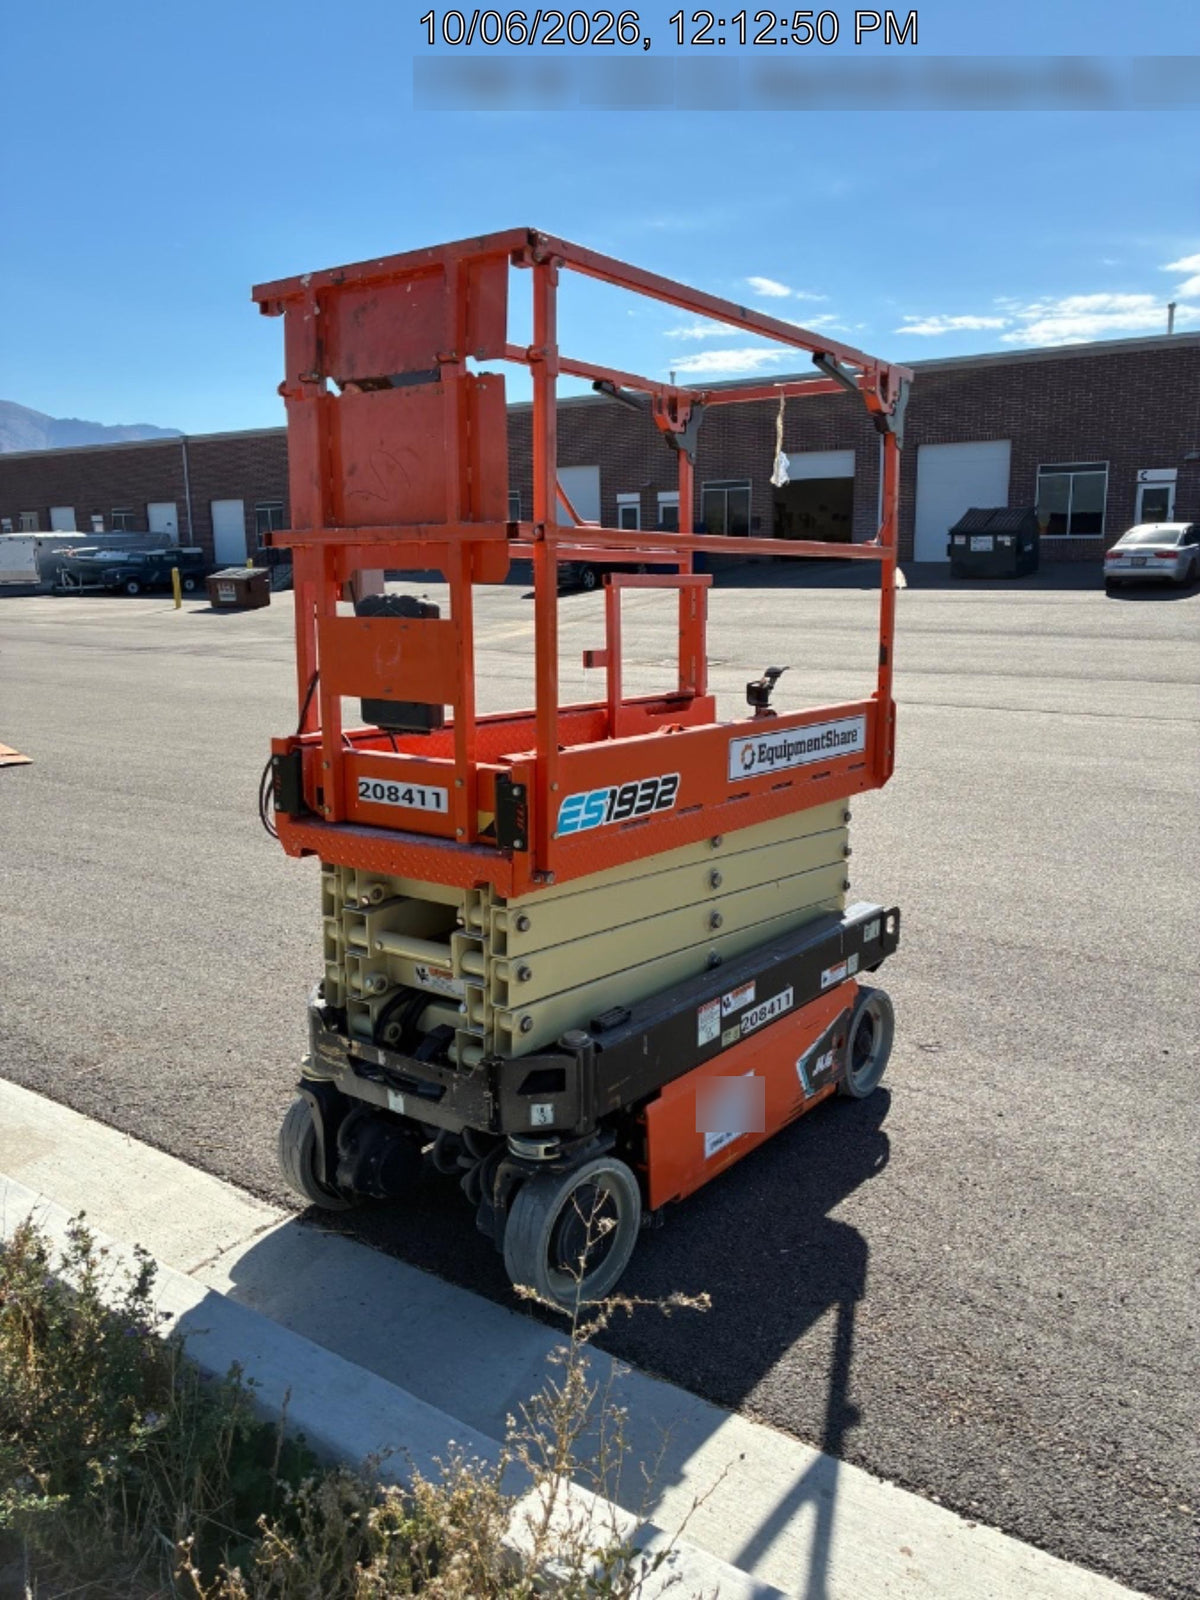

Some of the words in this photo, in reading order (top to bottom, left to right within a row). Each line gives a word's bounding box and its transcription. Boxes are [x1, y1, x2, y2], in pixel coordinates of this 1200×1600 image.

[757, 728, 858, 766] EquipmentShare
[358, 781, 442, 810] 208411
[557, 775, 679, 835] ES1932
[741, 992, 791, 1033] 208411
